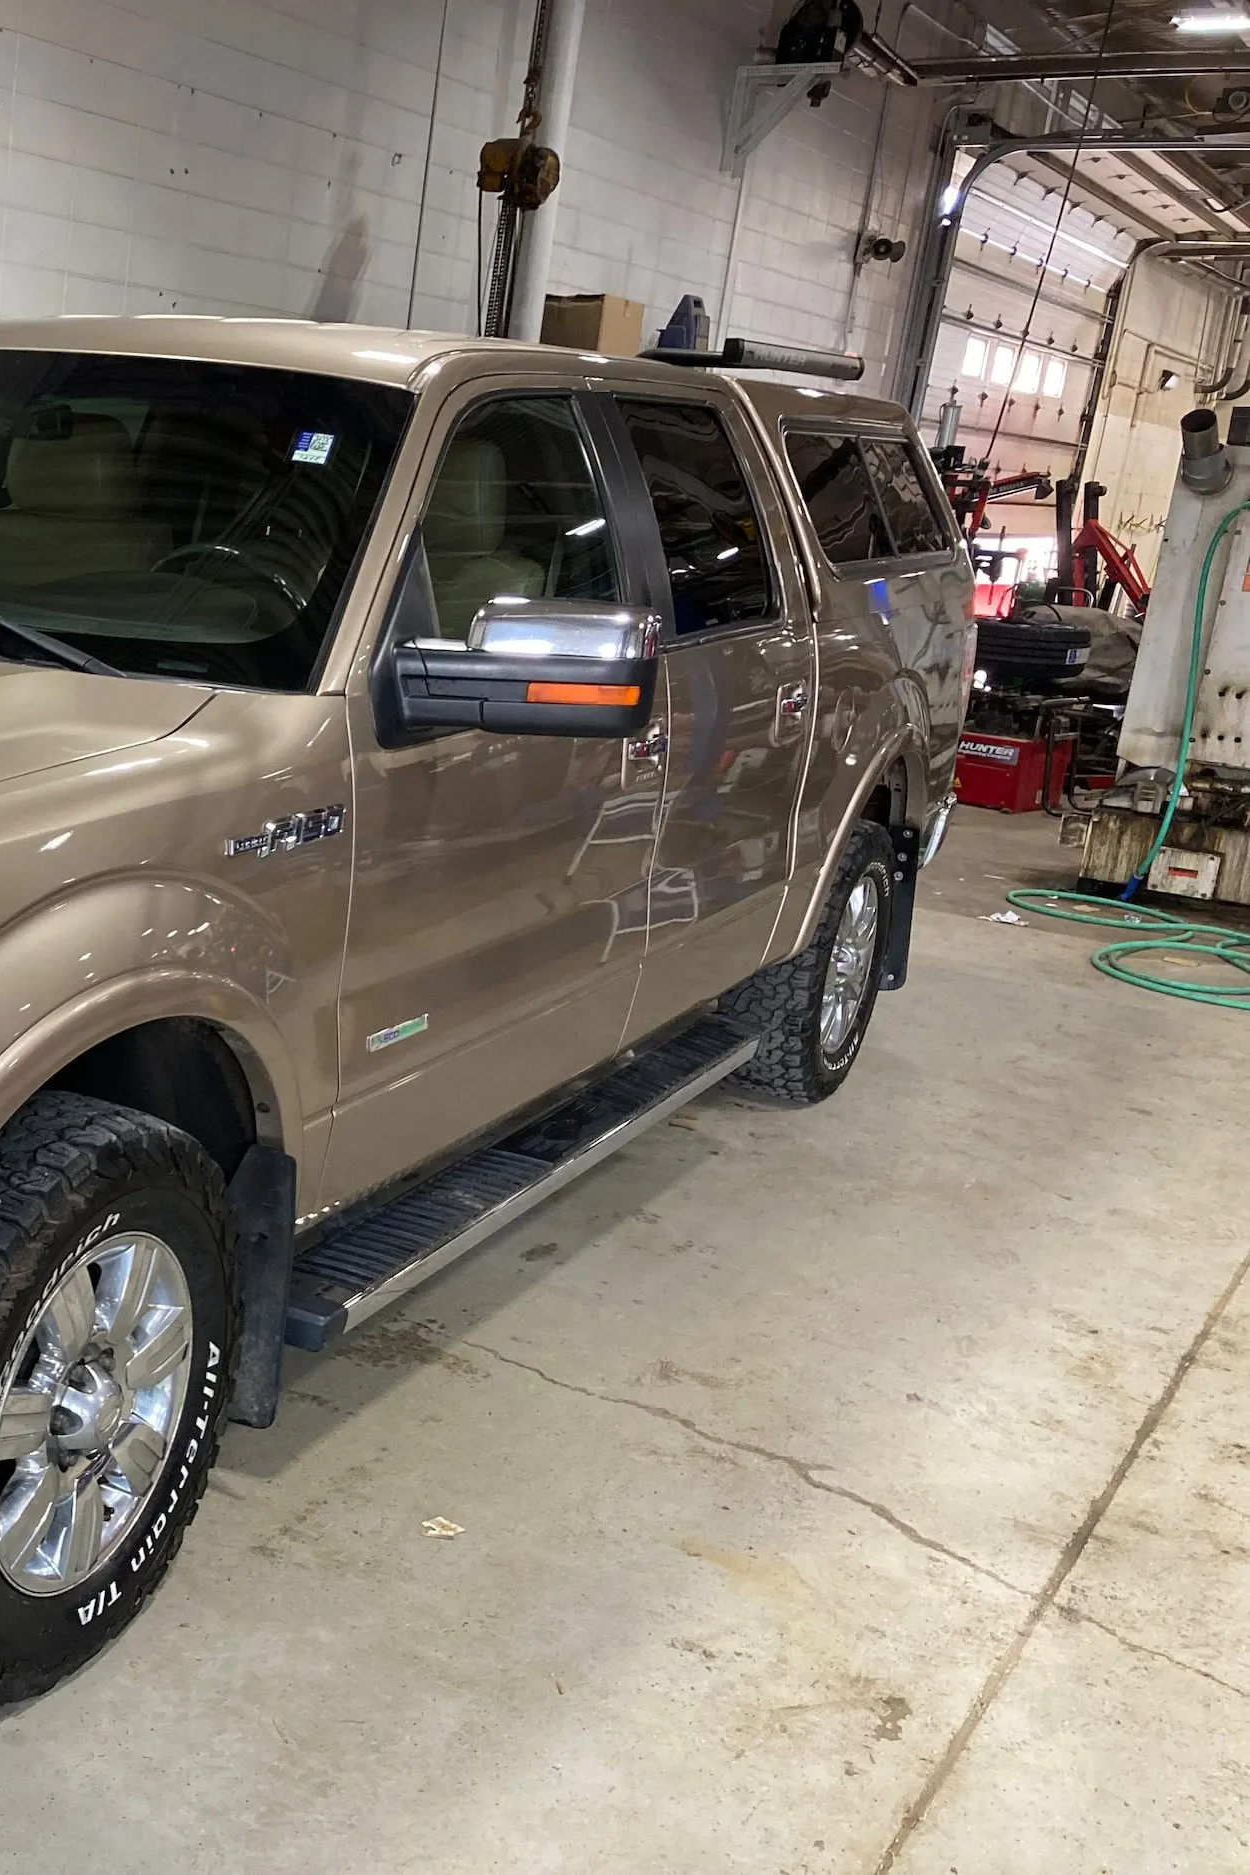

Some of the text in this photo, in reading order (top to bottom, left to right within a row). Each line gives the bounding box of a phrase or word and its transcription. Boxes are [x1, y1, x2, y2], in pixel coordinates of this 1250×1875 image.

[959, 740, 1015, 757] HUNTER
[77, 1340, 221, 1627] All-Terrain T/A
